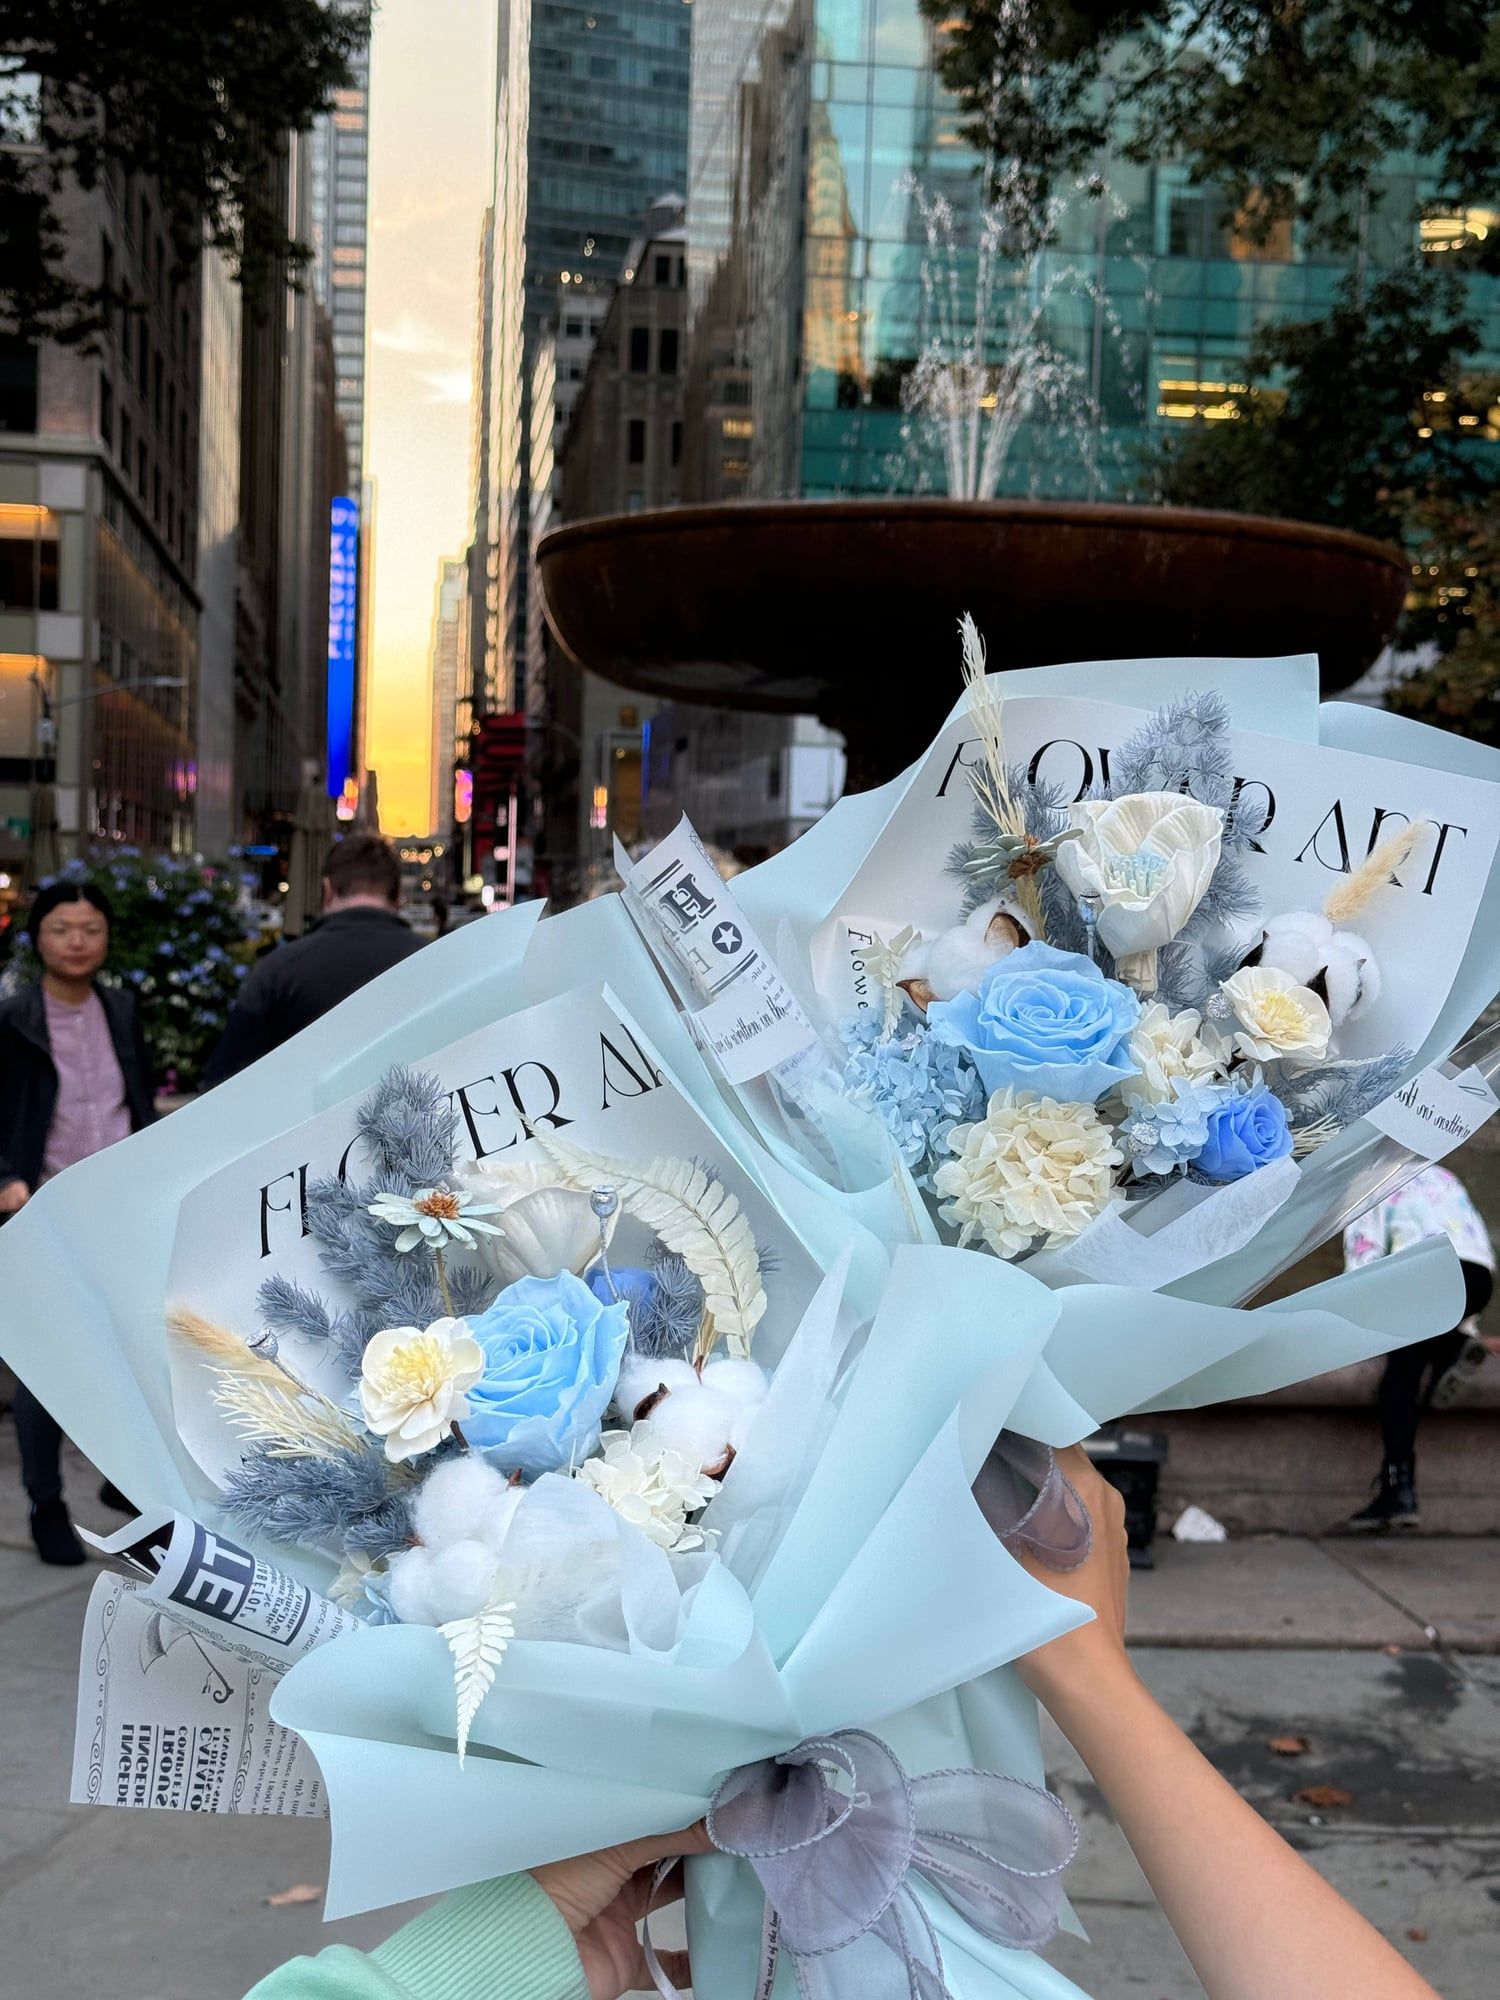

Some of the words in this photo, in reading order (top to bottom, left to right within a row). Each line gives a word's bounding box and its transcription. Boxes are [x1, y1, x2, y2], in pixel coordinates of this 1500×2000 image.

[731, 1017, 762, 1046] written
[756, 1011, 774, 1028] in
[260, 1061, 575, 1259] FLER
